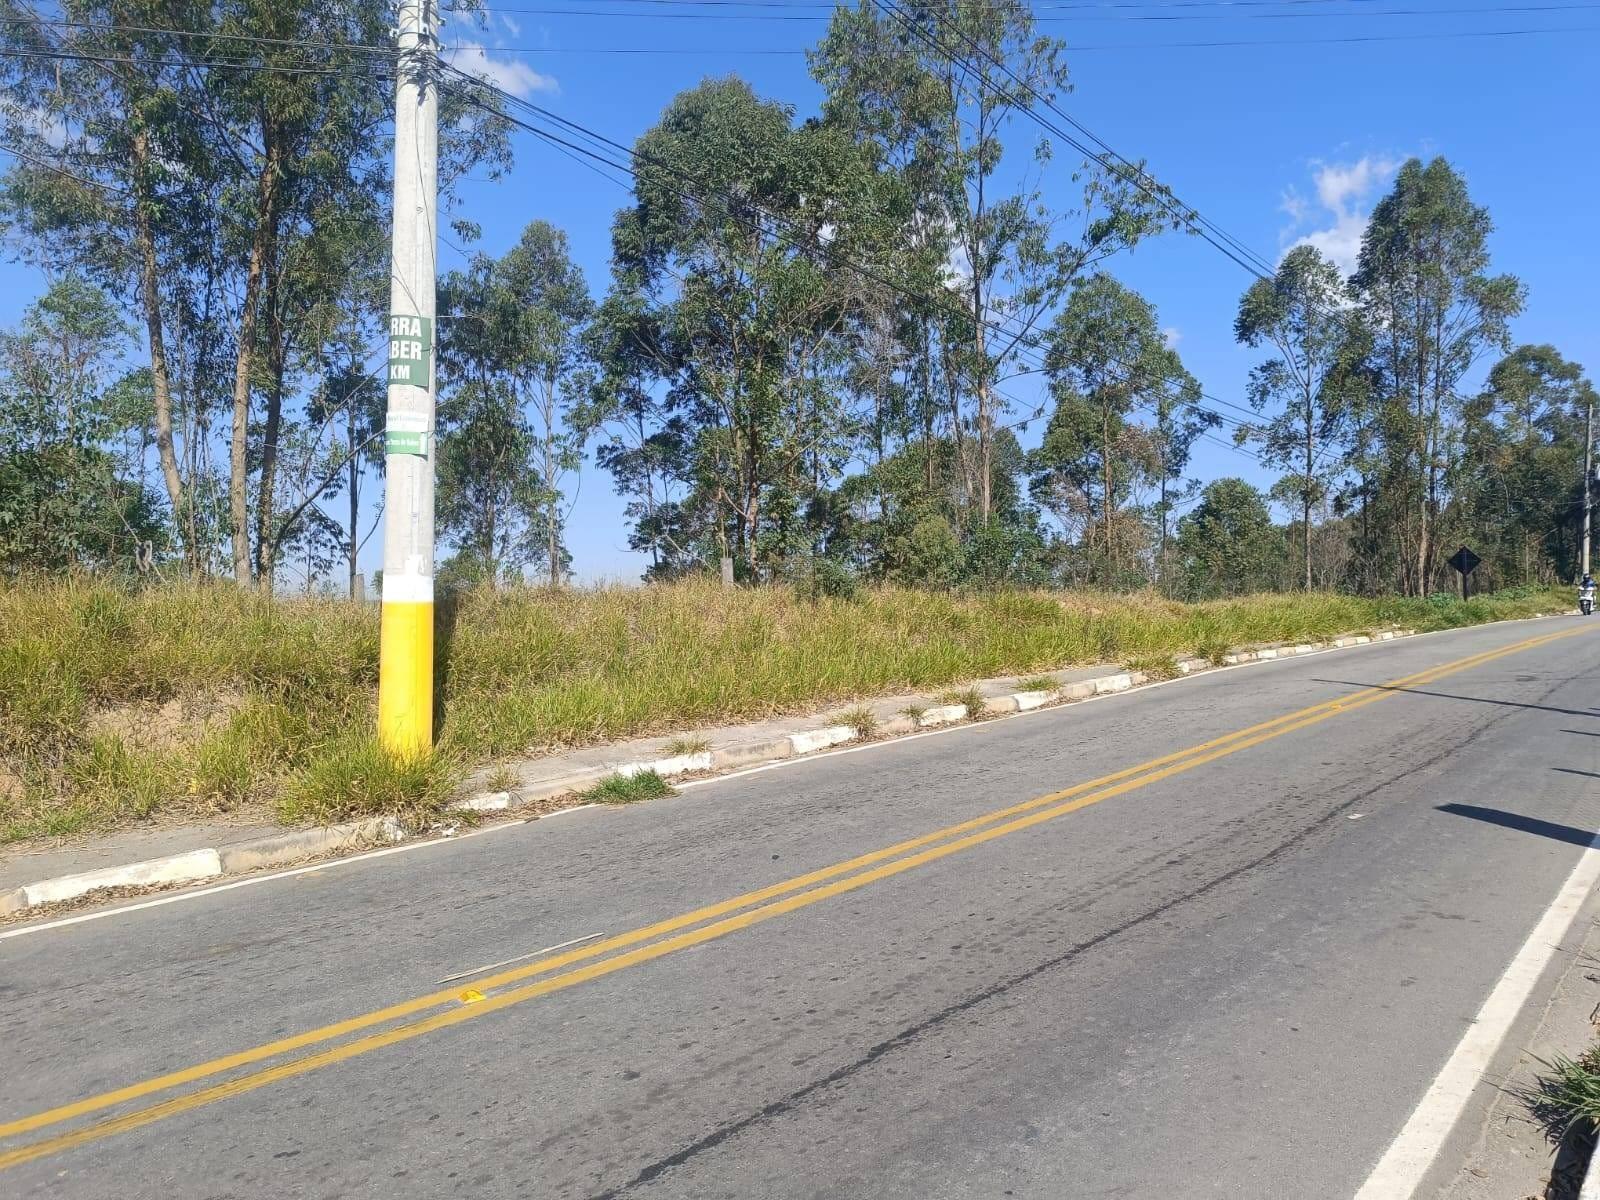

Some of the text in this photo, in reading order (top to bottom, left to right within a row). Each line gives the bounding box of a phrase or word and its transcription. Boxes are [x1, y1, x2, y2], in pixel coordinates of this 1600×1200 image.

[391, 318, 422, 337] RRA
[389, 340, 422, 361] BER
[390, 365, 411, 380] KM
